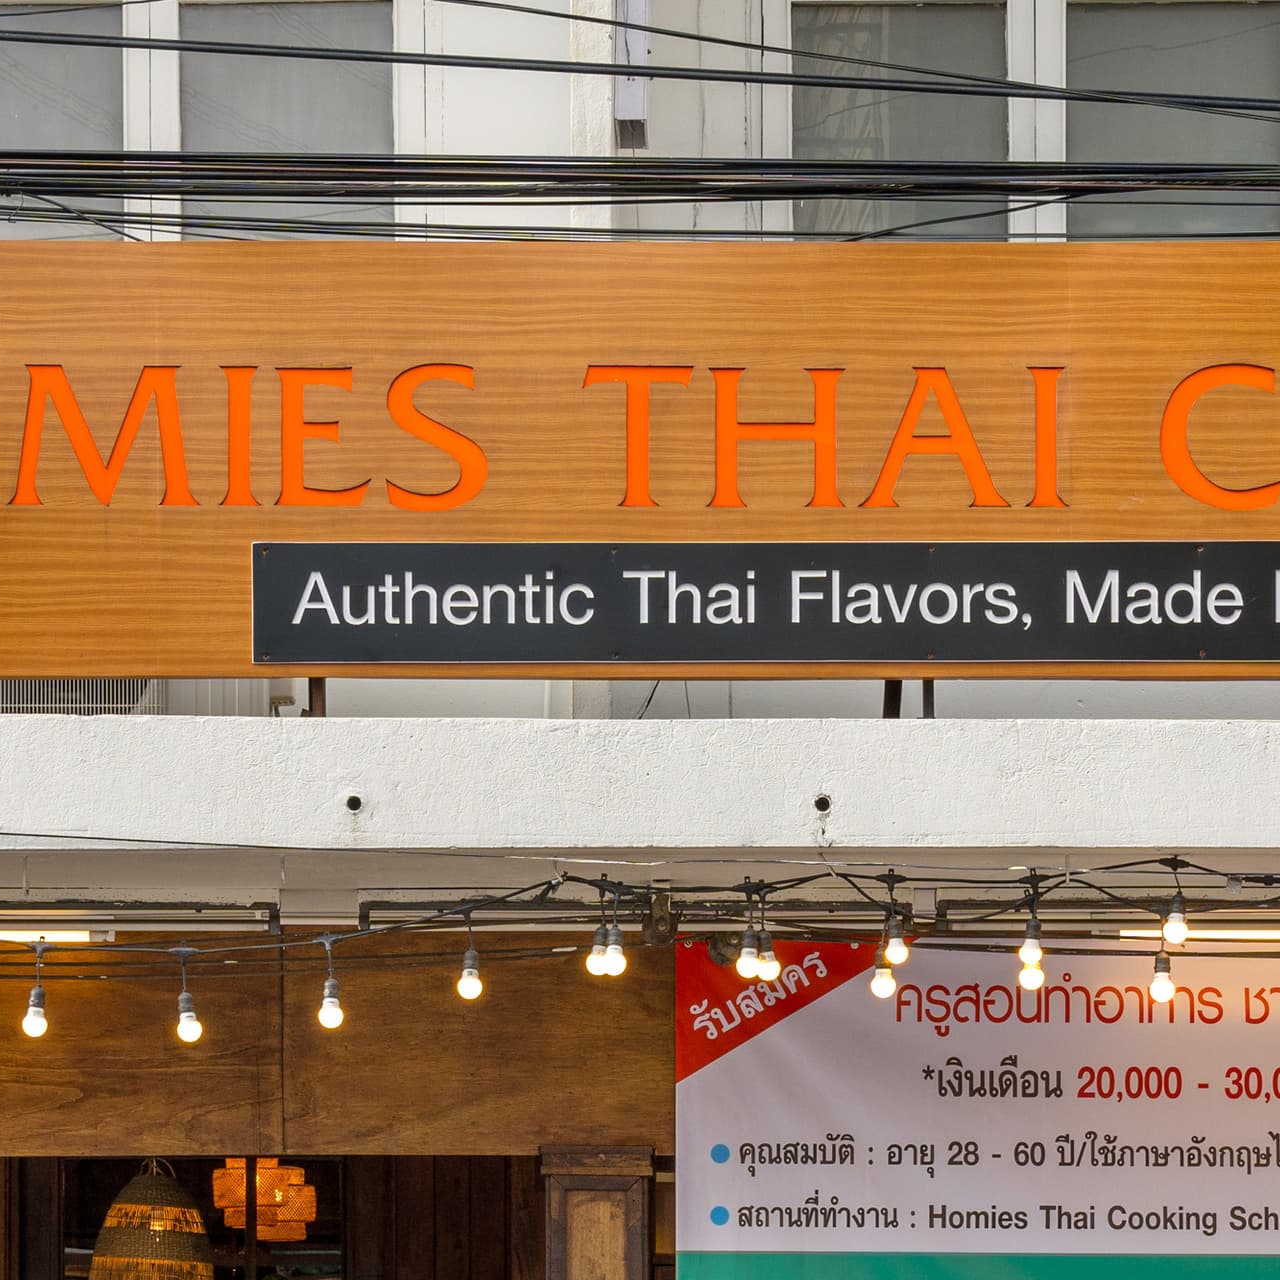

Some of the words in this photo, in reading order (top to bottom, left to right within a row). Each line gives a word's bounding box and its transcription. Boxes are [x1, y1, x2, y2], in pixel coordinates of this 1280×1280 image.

[583, 366, 1066, 509] THAI
[291, 569, 595, 627] Authentic
[621, 569, 756, 626] Thai
[790, 569, 1033, 631] Flavors,
[1065, 569, 1245, 626] Made
[689, 951, 828, 1040] รับสมคร
[1076, 1065, 1183, 1101] 20,000
[738, 1132, 856, 1178] คุณสมบัติ
[867, 1145, 875, 1167] :
[886, 1143, 936, 1179] อายุ
[946, 1140, 980, 1167] 28
[1013, 1141, 1047, 1168] 60
[736, 1188, 900, 1229] สถานที่ทำงาน
[909, 1209, 917, 1229] :
[928, 1204, 1028, 1231] Homies
[1039, 1205, 1096, 1231] Thai
[1107, 1204, 1218, 1237] Cooking
